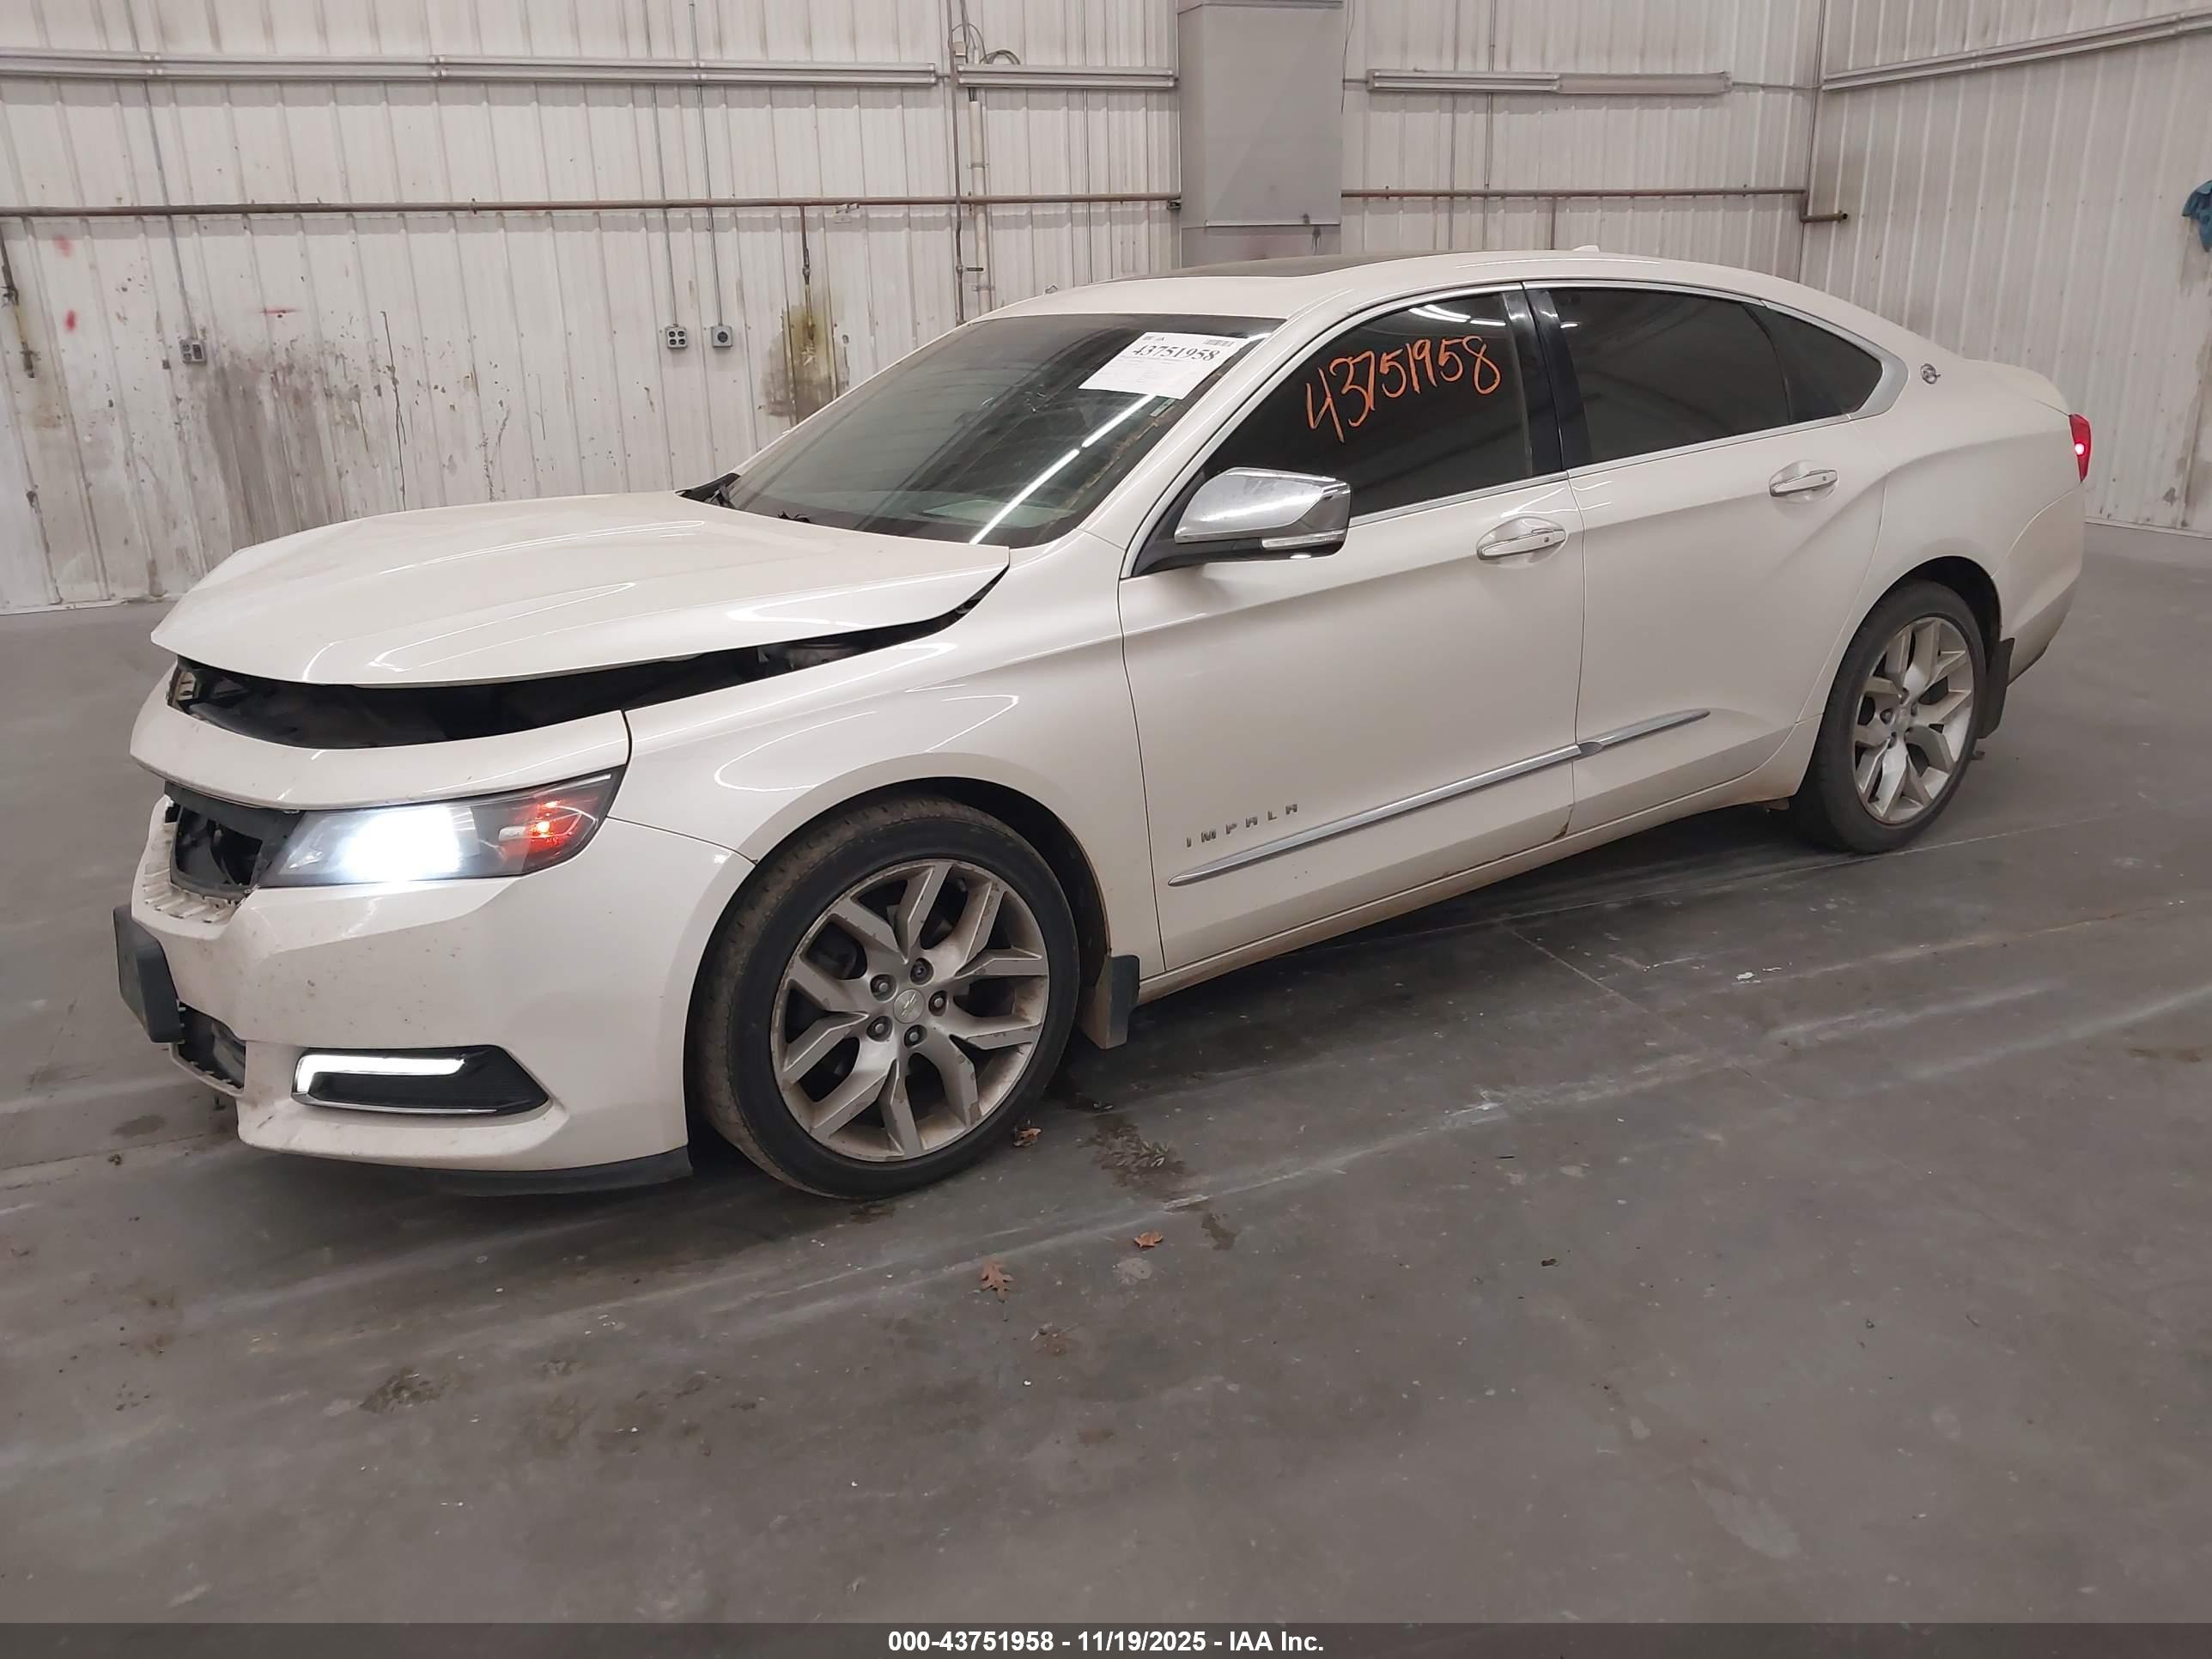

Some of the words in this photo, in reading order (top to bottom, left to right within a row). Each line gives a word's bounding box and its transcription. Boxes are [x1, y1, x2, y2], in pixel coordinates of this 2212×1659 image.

[1133, 344, 1220, 362] 43751958
[1305, 334, 1501, 443] 43751958
[1186, 804, 1297, 848] IMPALA
